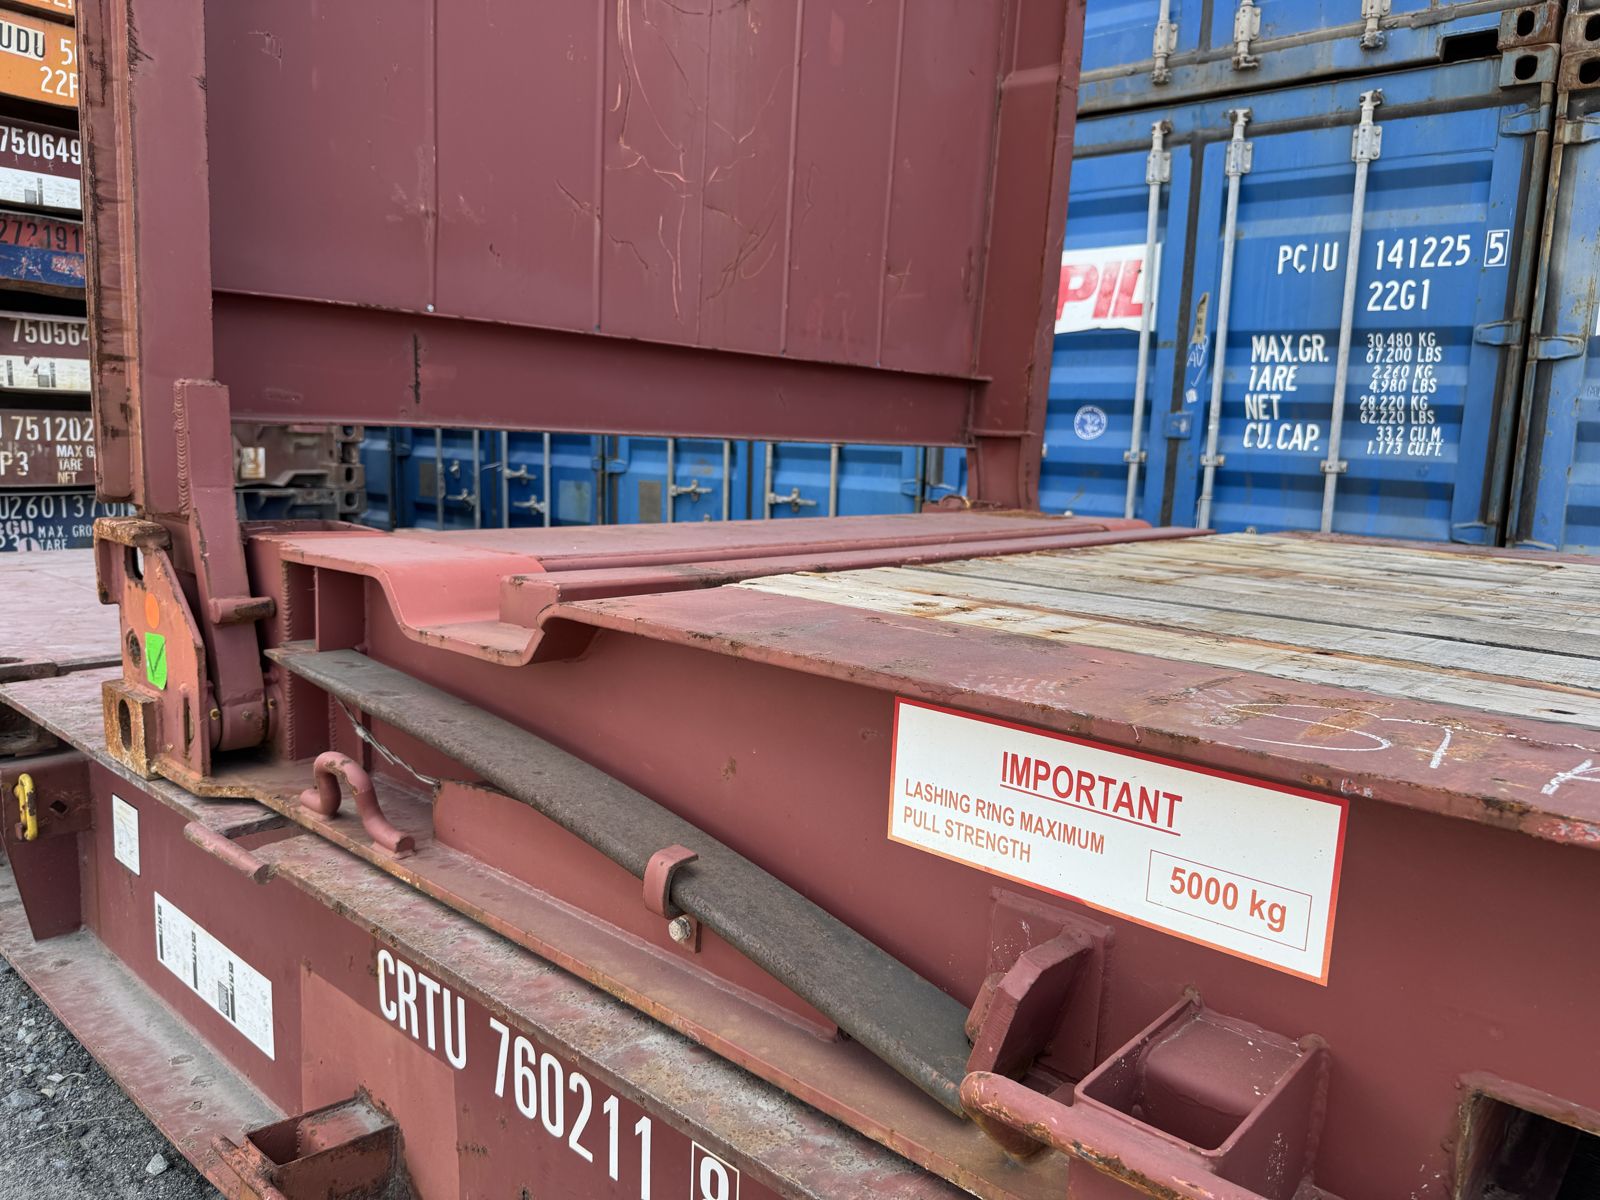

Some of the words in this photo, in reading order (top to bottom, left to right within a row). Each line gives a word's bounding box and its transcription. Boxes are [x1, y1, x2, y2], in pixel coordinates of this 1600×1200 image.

[1277, 240, 1340, 275] PCIU
[1375, 234, 1472, 270] 141225
[1486, 231, 1507, 266] 5
[1055, 259, 1153, 321] PIL
[1366, 279, 1431, 312] 22G1
[1251, 334, 1330, 363] MAX.GR.
[1365, 347, 1412, 363] 67.200
[1417, 346, 1443, 363] LBS
[1366, 332, 1413, 349] 30.480
[1418, 332, 1436, 347] KG
[1248, 364, 1298, 392] TARE
[1411, 377, 1438, 394] LBS
[1414, 364, 1434, 380] KG
[1244, 393, 1282, 421] NET
[1359, 395, 1406, 411] 28.220
[1410, 395, 1429, 411] KG
[1359, 410, 1406, 425] 62.220
[1410, 409, 1436, 425] LBS
[56, 444, 84, 458] MAX
[58, 457, 84, 472] TARE
[1001, 750, 1183, 829] IMPORTANT
[904, 777, 971, 814] LASHING
[975, 800, 1015, 828] RING
[1019, 813, 1106, 855] MAXIMUM
[903, 804, 940, 835] PULL
[944, 815, 1032, 864] STRENGTH
[1169, 865, 1240, 912] 5000
[1249, 888, 1288, 933] kg
[377, 948, 468, 1071] CRTU
[489, 1016, 652, 1200] 760211
